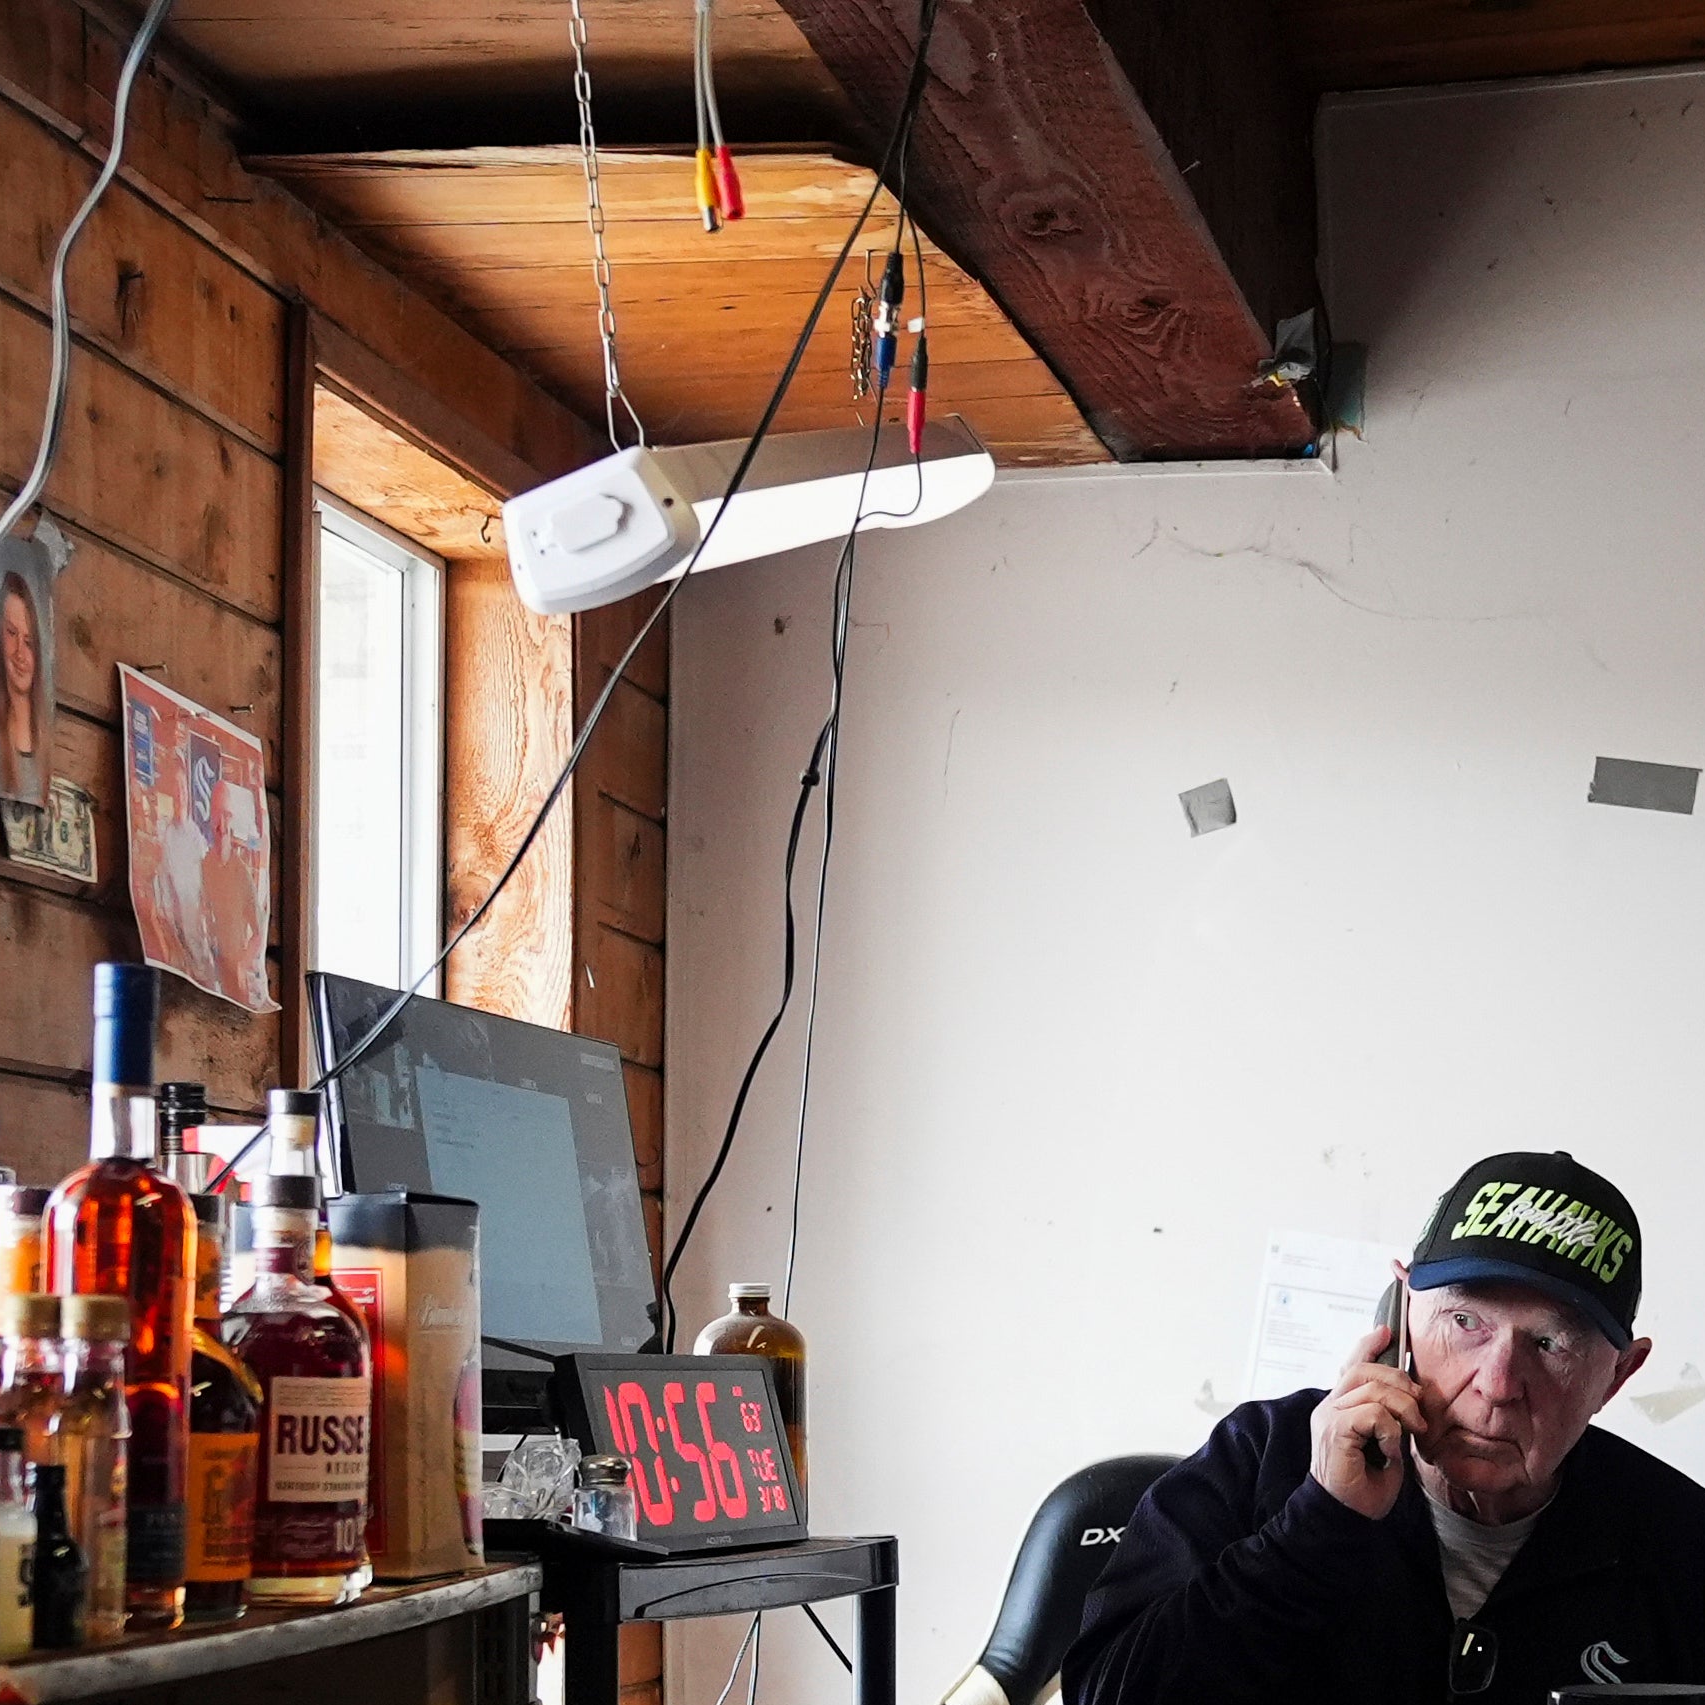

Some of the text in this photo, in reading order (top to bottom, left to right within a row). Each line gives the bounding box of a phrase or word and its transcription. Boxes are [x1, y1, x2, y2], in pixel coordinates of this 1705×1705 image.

[1450, 1181, 1633, 1284] SEAHAWKS
[603, 1382, 747, 1527] 10:56
[747, 1448, 779, 1482] TUE
